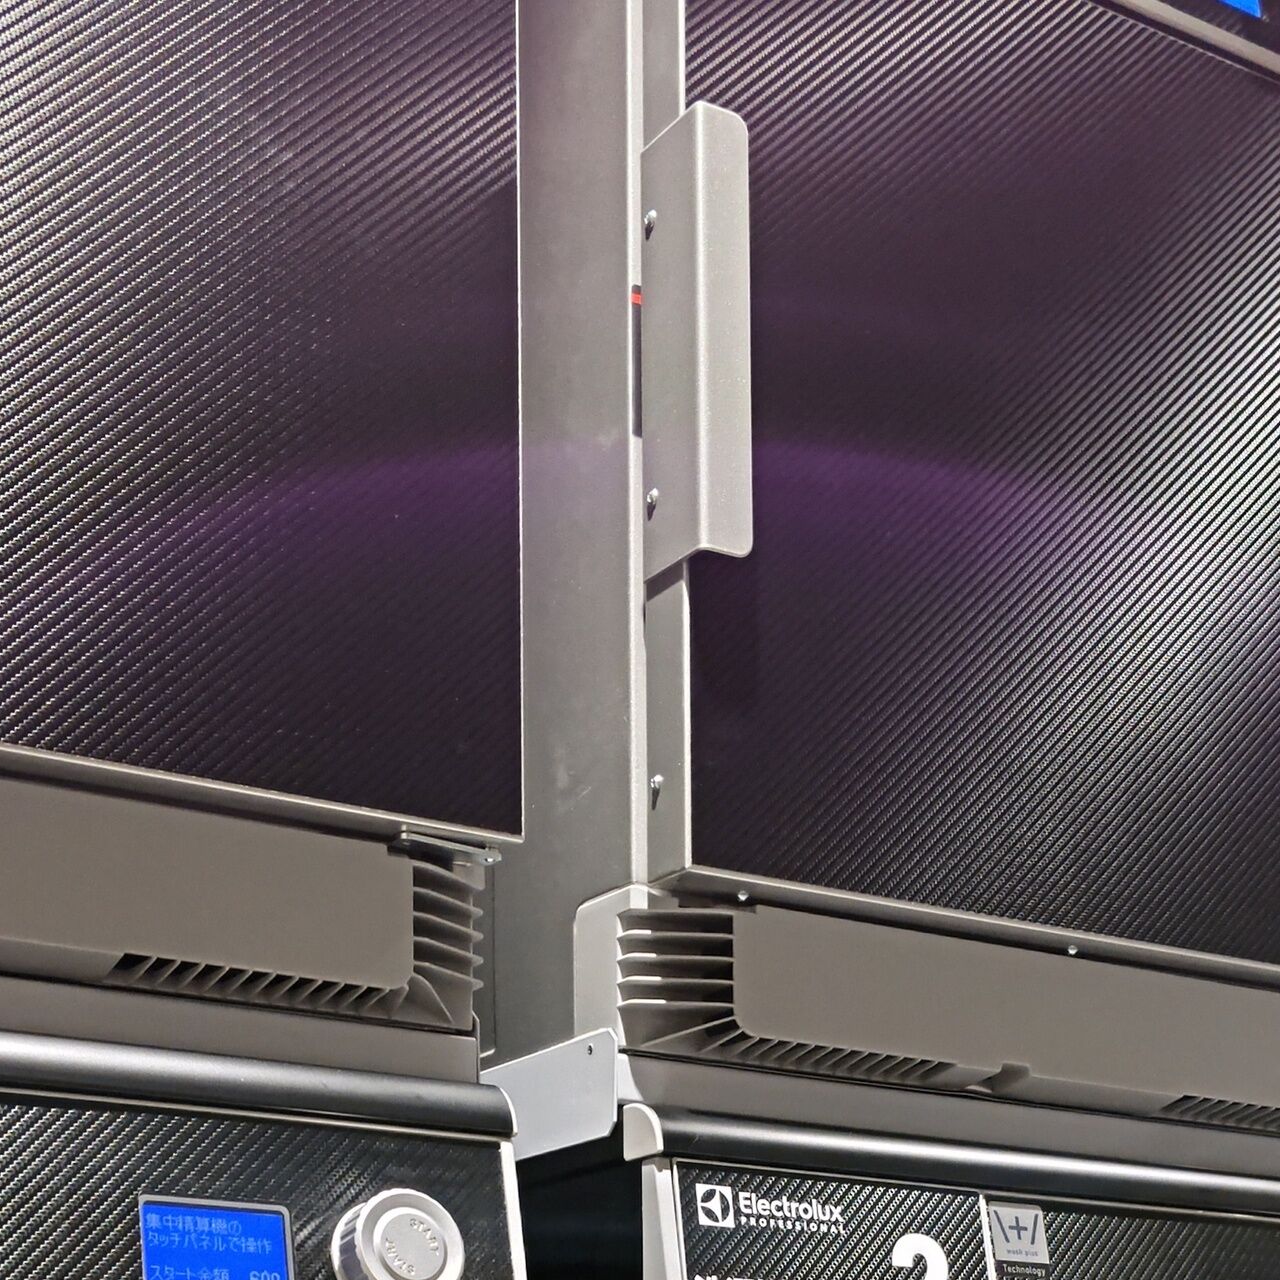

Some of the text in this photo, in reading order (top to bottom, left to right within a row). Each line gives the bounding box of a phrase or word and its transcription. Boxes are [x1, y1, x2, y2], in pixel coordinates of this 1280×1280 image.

[738, 1191, 844, 1222] Electrolux
[740, 1216, 846, 1234] PROFESSIONAL
[148, 1232, 271, 1254] タッチパネルで操作
[409, 1217, 439, 1256] START
[1003, 1263, 1046, 1277] Technology
